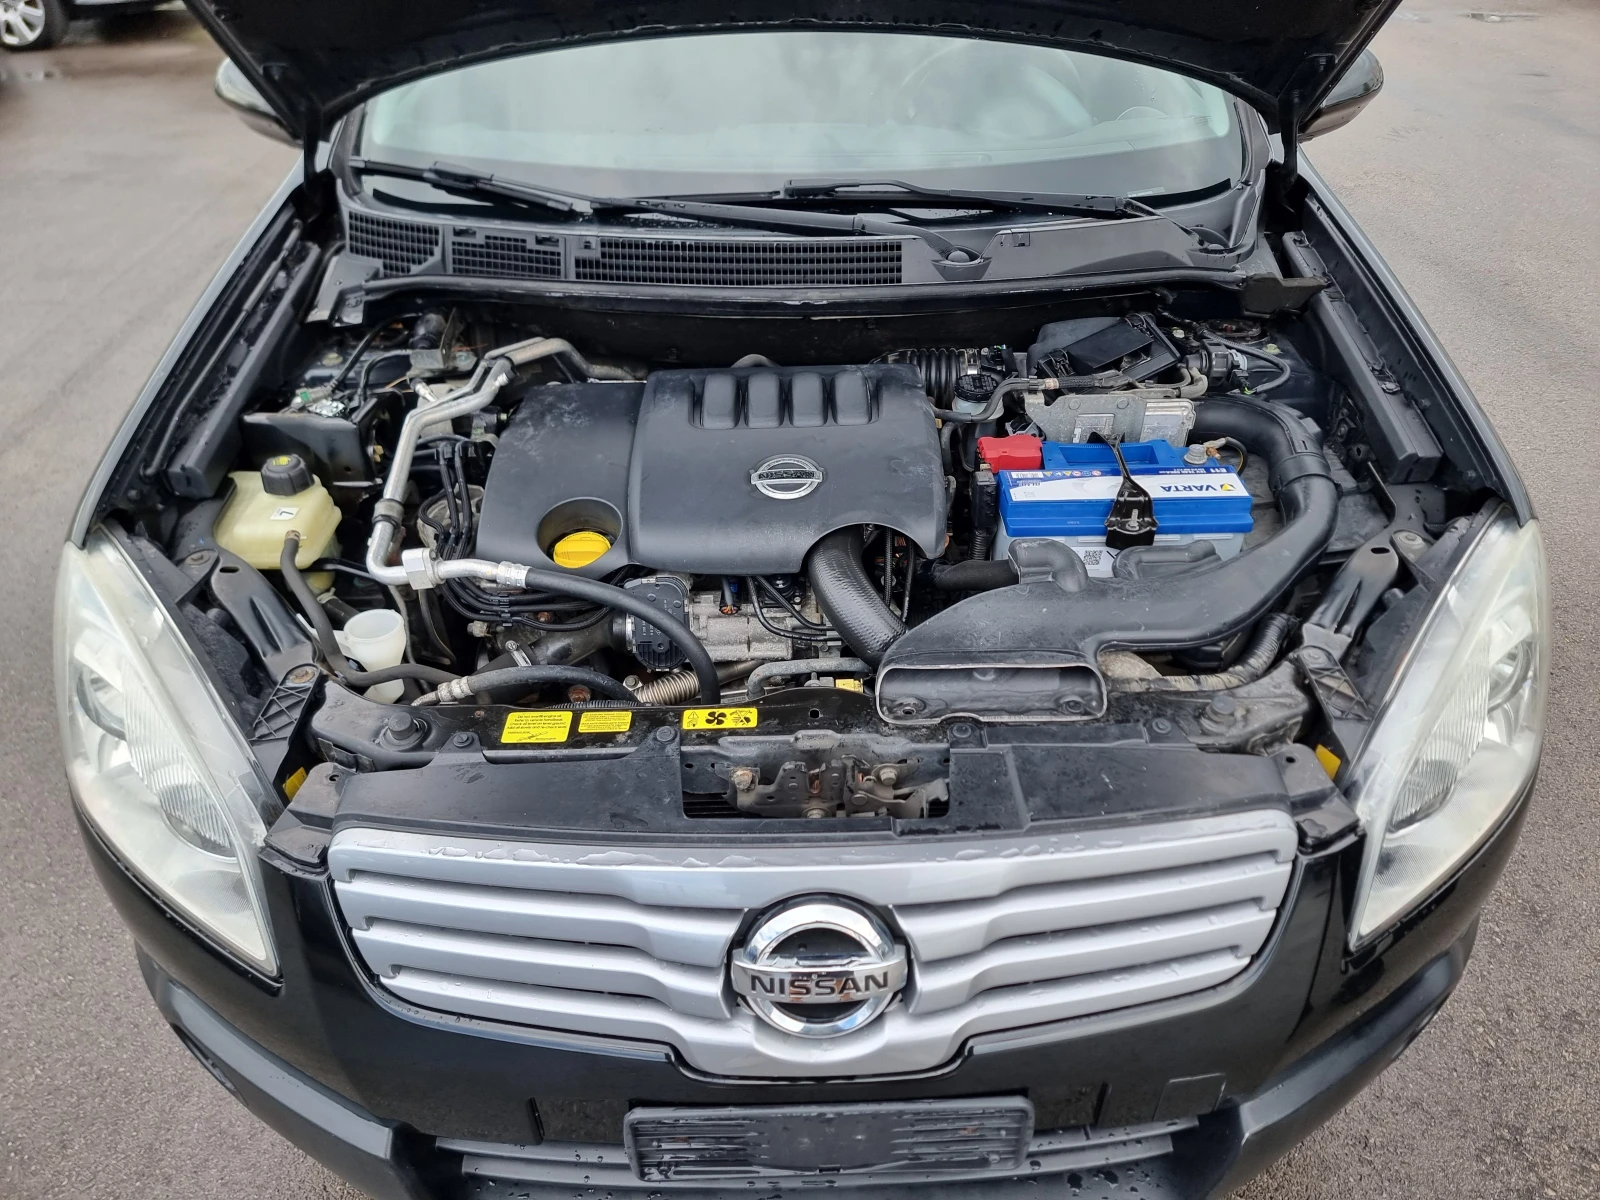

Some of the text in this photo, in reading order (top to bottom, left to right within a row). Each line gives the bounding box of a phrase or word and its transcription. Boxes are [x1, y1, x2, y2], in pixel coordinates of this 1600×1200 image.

[758, 470, 815, 479] NISSAN
[1160, 484, 1218, 492] VARTA
[750, 971, 888, 997] NISSAN
